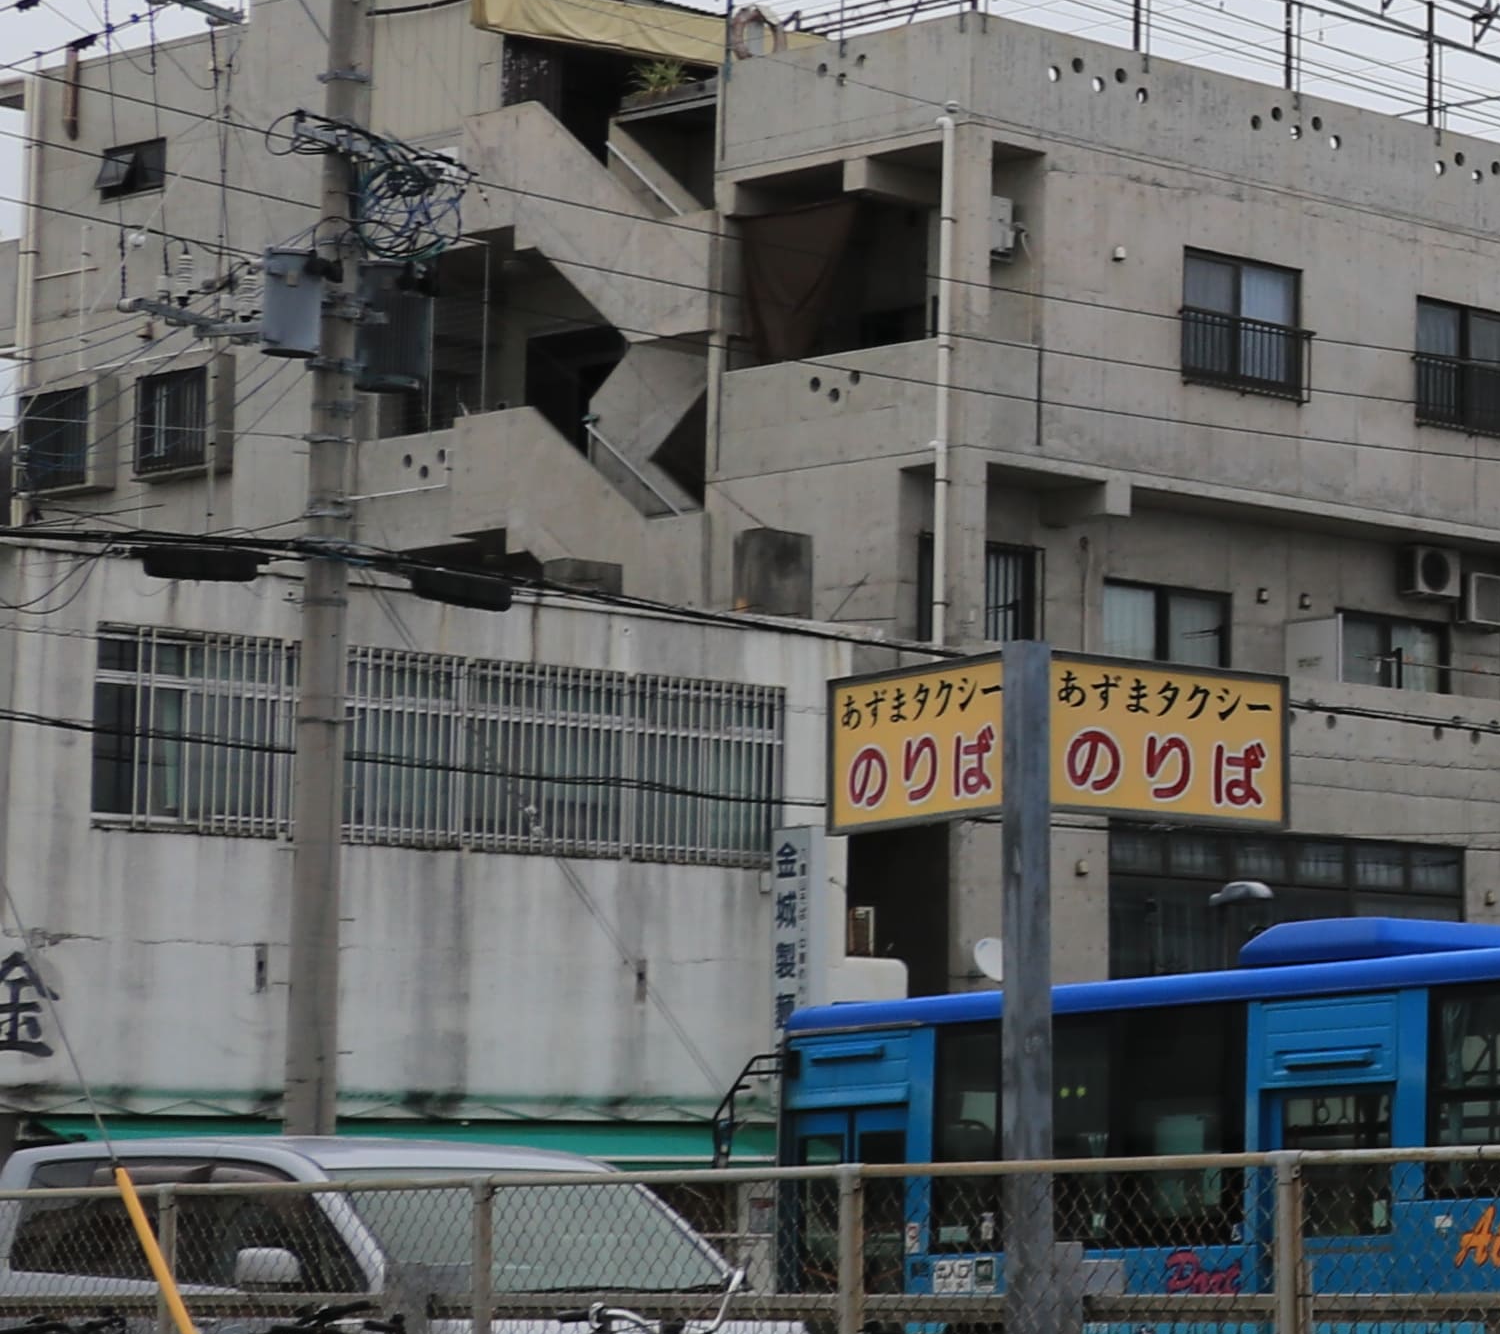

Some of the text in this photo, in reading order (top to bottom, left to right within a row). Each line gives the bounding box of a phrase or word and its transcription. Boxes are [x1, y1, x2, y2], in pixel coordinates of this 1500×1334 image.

[841, 676, 1003, 730] あずまタクシー
[1057, 670, 1273, 721] あずまタクシー
[848, 724, 995, 807] のりば
[1066, 730, 1266, 806] のりば
